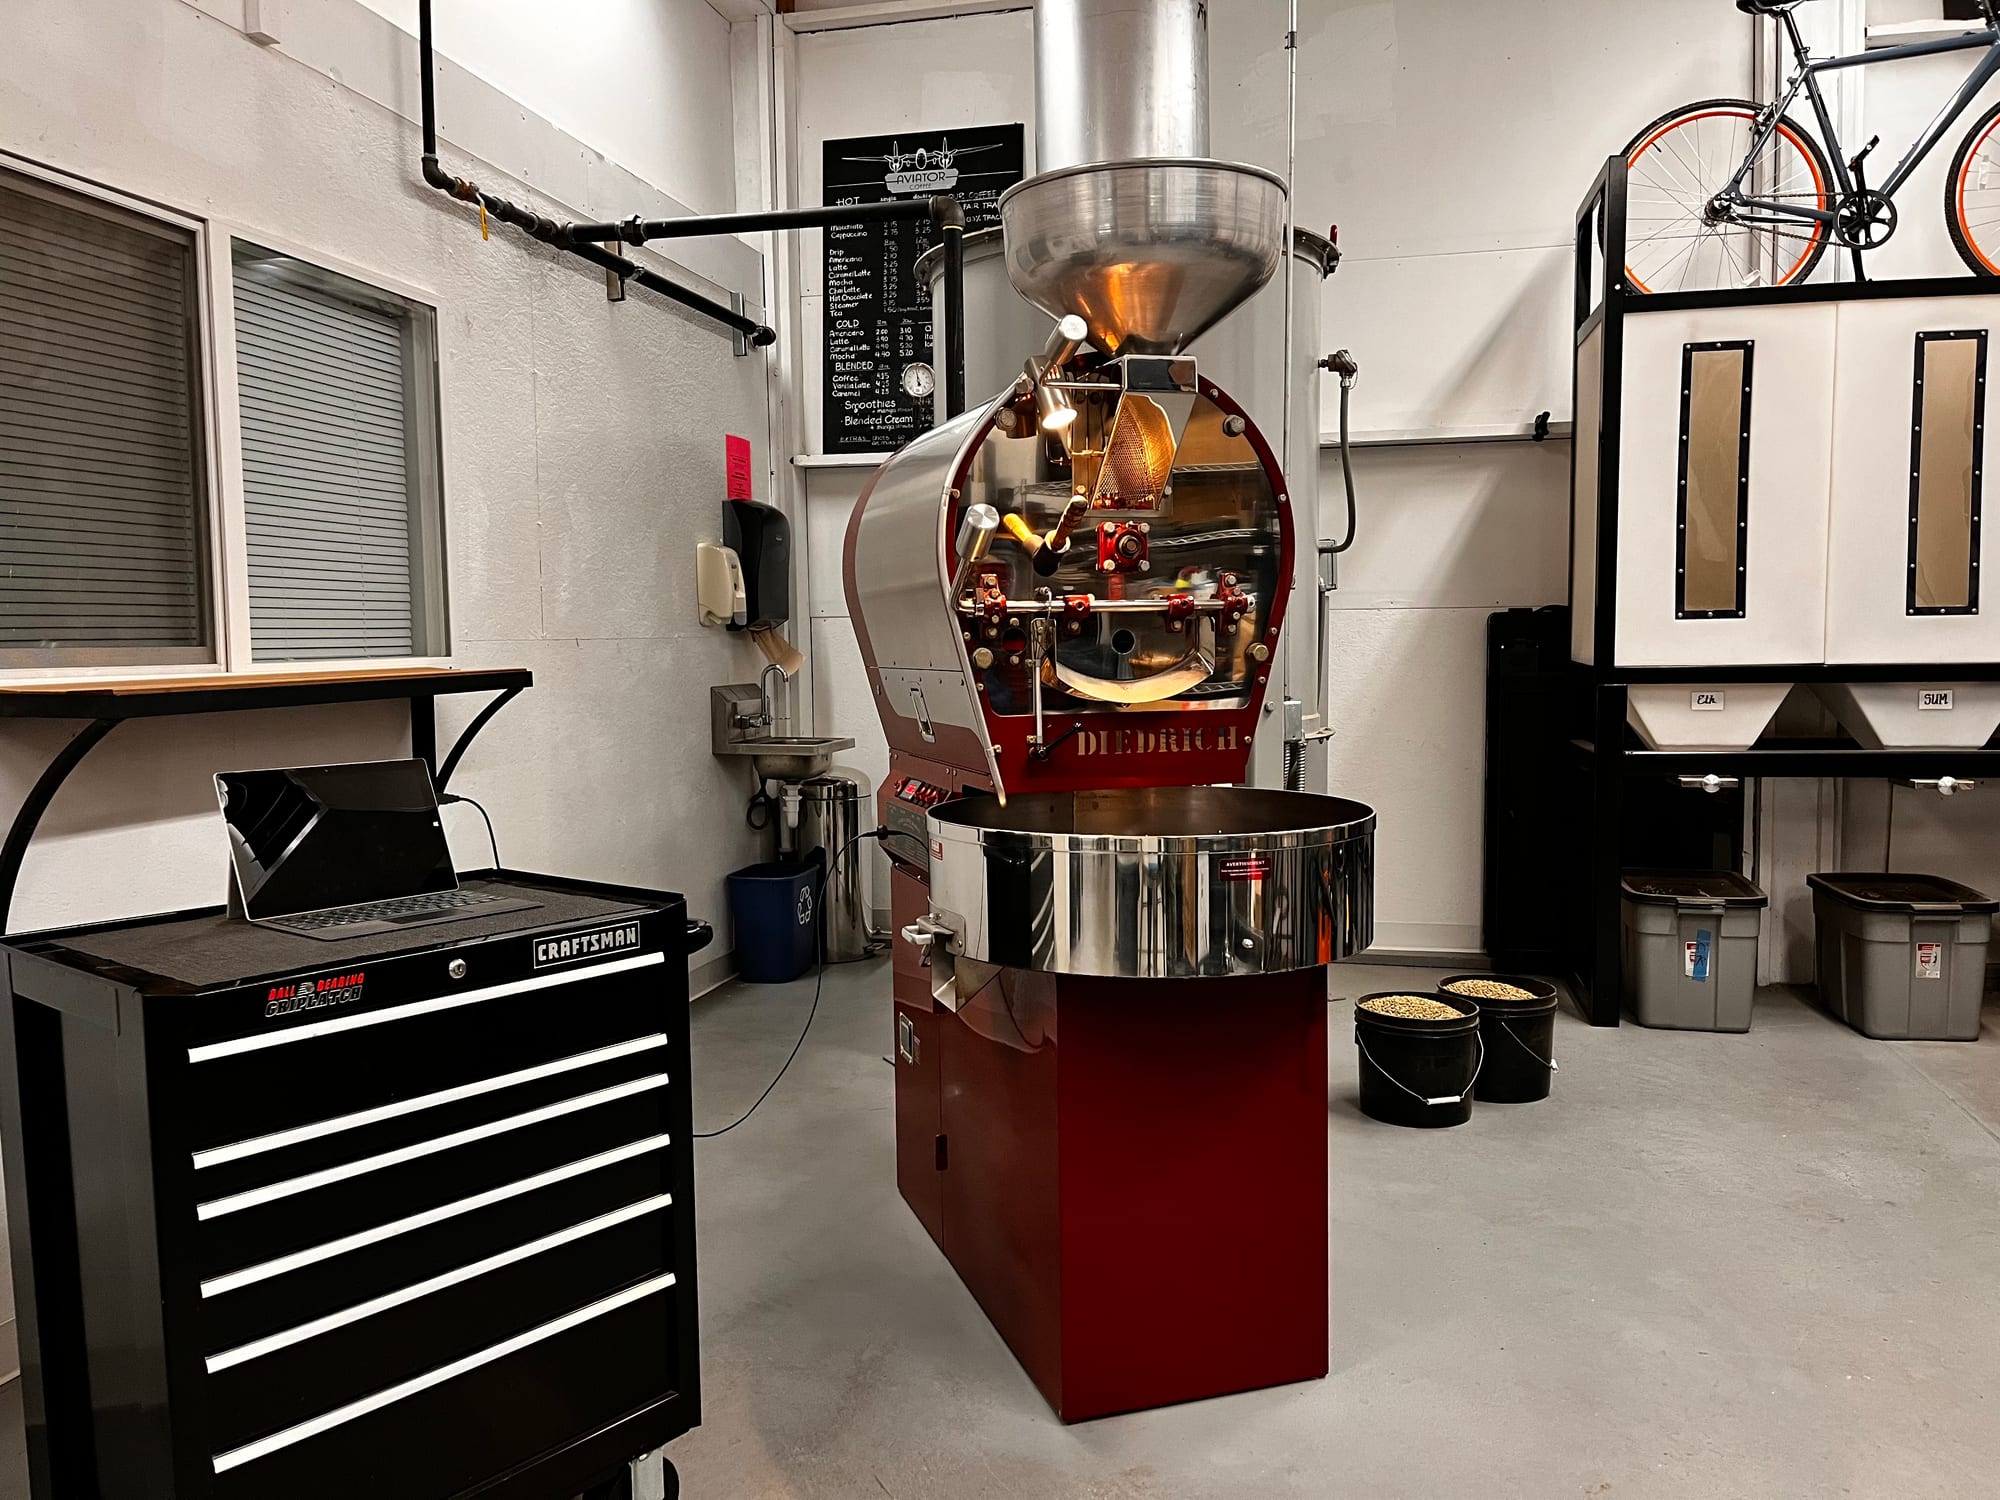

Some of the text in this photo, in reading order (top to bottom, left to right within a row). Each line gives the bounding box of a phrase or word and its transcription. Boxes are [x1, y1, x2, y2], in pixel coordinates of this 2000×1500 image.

[897, 172, 946, 184] AVIATOR
[835, 196, 860, 206] HOT
[828, 278, 853, 287] Mocha
[829, 302, 859, 310] Steamer
[829, 309, 843, 318] Tea
[836, 319, 860, 328] COLD
[835, 361, 874, 371] BLENDED
[844, 400, 896, 411] Smoothies
[844, 415, 882, 426] Blended
[884, 414, 913, 424] Cream
[1077, 726, 1238, 756] DIEDRICH
[537, 927, 637, 961] CRAFTSMAN
[268, 985, 296, 1001] BALL
[264, 985, 363, 1018] GRIPLATCH
